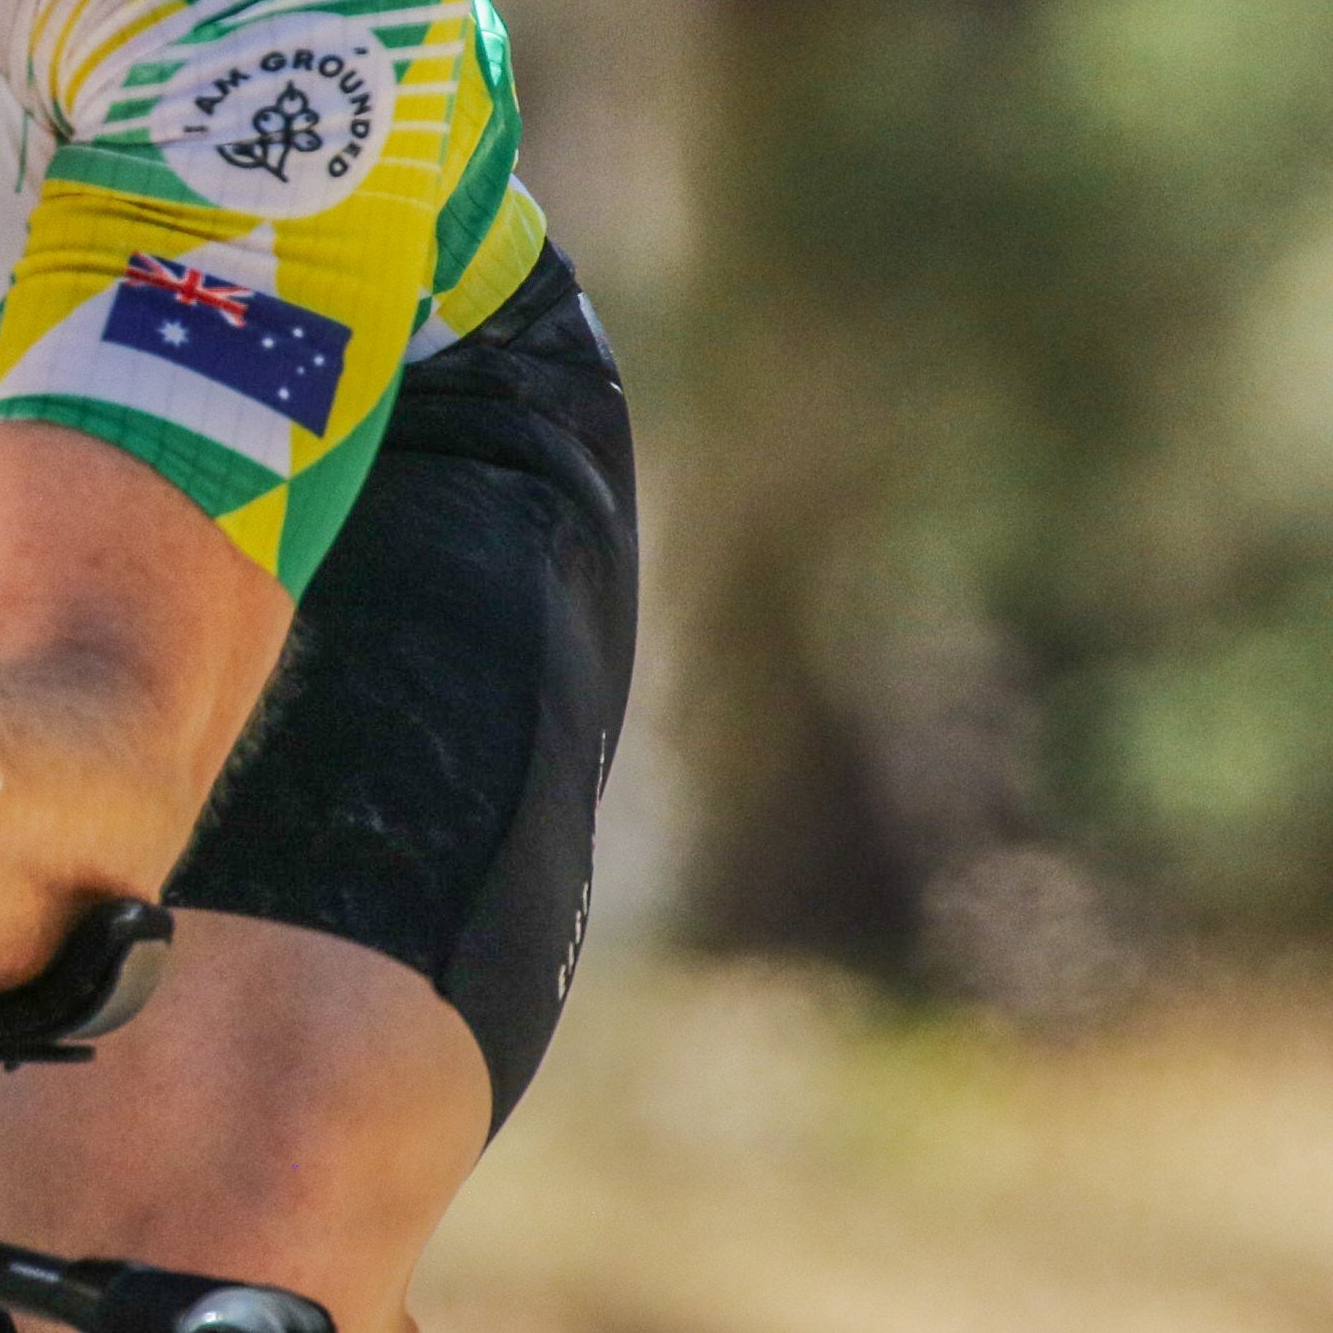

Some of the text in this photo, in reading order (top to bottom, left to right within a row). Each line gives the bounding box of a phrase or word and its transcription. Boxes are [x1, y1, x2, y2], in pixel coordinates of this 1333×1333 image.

[184, 48, 371, 178] I AM GROUNDED
